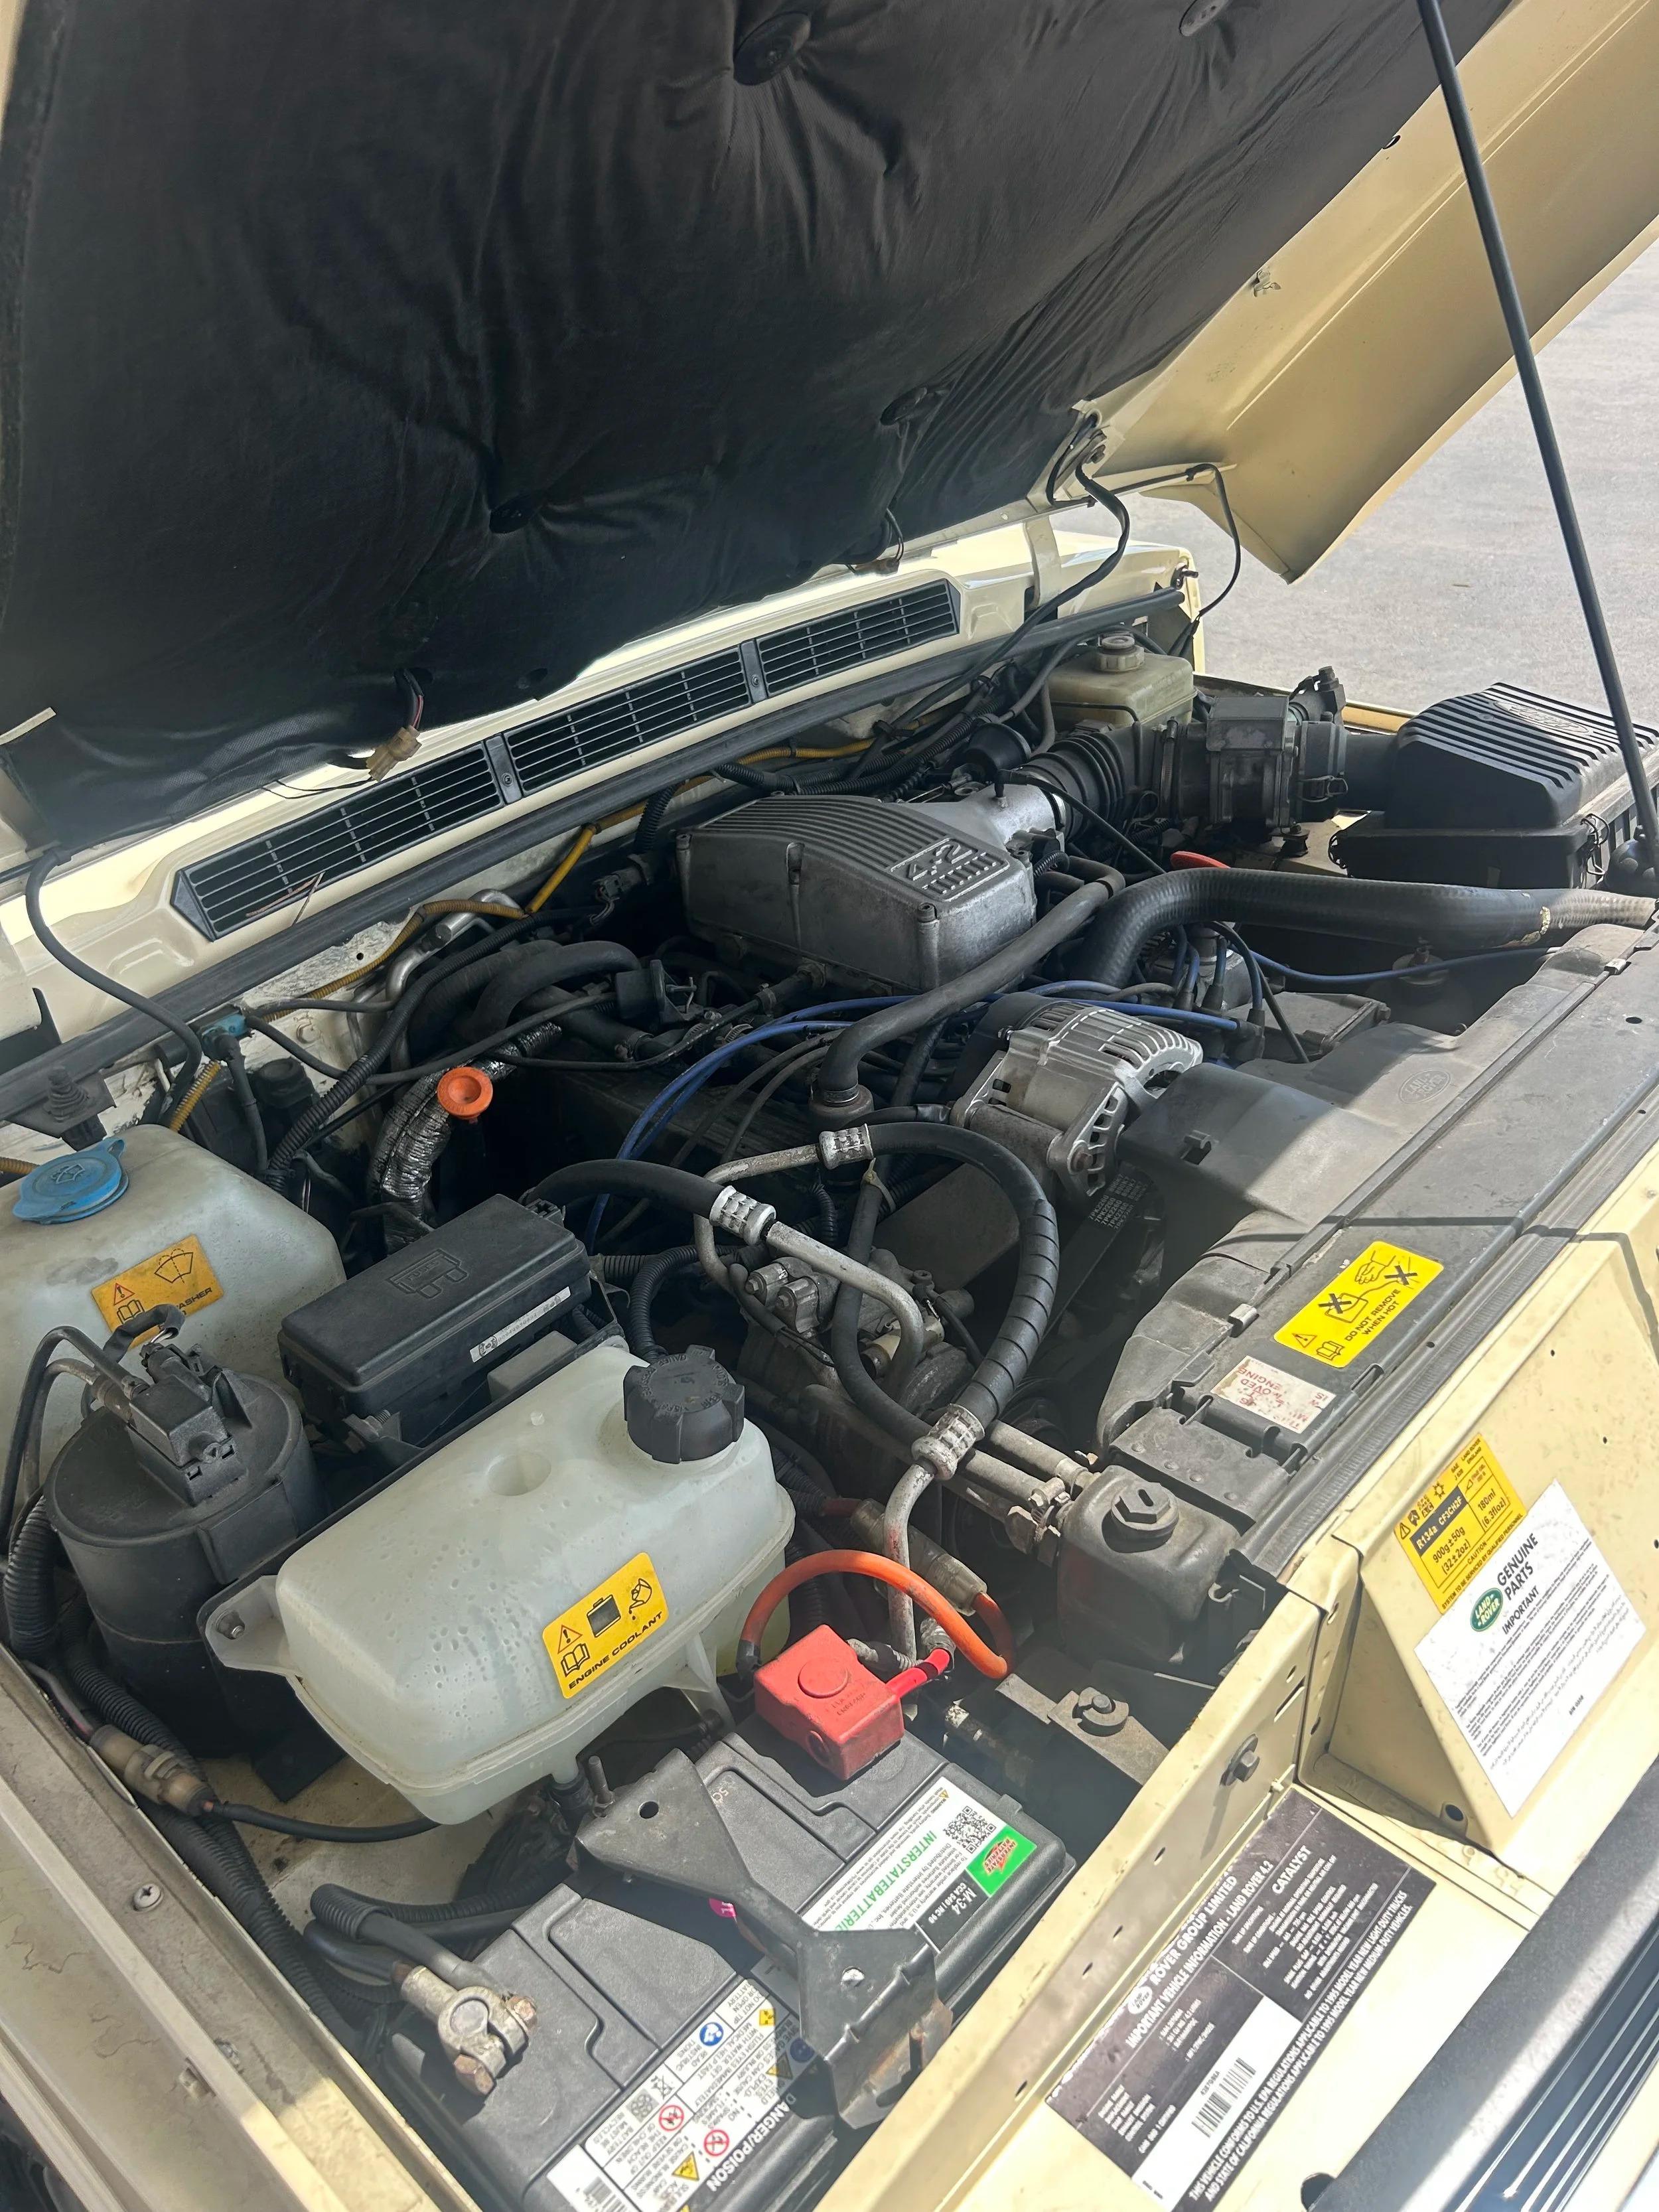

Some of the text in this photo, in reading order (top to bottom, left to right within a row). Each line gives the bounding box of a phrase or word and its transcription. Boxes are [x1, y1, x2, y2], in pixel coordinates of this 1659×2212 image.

[173, 1287, 213, 1313] ASHER
[1344, 1288, 1401, 1342] DO NOT REMOVE
[1361, 1299, 1401, 1336] WHEN HOT
[1236, 1366, 1282, 1390] ENGINE
[1450, 1438, 1481, 1474] SAE LAND ROVER
[1466, 1445, 1482, 1465] ENGLAND
[1477, 1487, 1496, 1512] 180ml
[1415, 1493, 1463, 1551] R134a CF3CH2F
[1441, 1511, 1523, 1609] SYSTEM TO BE SERVICED BY QUALIFIED PERSONNEL
[1467, 1539, 1487, 1565] CAUTION
[1494, 1531, 1539, 1589] GENUINE
[1503, 1559, 1534, 1601] PARTS
[1501, 1584, 1540, 1635] IMPORTANT
[568, 1611, 664, 1690] ENGINE COOLANT
[925, 1841, 952, 1868] Distributed
[939, 1856, 956, 1873] limited
[951, 1849, 962, 1860] For
[958, 1854, 968, 1862] To
[982, 1838, 1011, 1868] BATTERIES
[985, 1840, 1017, 1874] INTERSTATE
[920, 1864, 930, 1873] by
[934, 1874, 950, 1888] under
[944, 1859, 963, 1877] replace
[1269, 1844, 1313, 1895] CATALYST
[887, 1846, 958, 1919] Interstate Batteries authorized dealer
[899, 1870, 924, 1894] Interstate
[914, 1887, 927, 1898] see
[918, 1885, 939, 1905] warranty
[926, 1881, 968, 1924] CCA 540 RC 90
[948, 1886, 978, 1915] M-34
[1387, 1889, 1408, 1914] TRUCKS
[897, 1915, 910, 1927] and
[1388, 1901, 1413, 1932] VEHICLES.
[1147, 1947, 1182, 1986] ROVER
[1175, 1911, 1210, 1951] GROUP
[1202, 1874, 1240, 1915] LIMITED
[1123, 1998, 1167, 2049] IMPORTANT
[1159, 1968, 1190, 2004] VEHICLE
[1182, 1917, 1230, 1974] INFORMATION
[1224, 1893, 1248, 1919] LAND
[1240, 1870, 1266, 1899] ROVER
[1257, 1858, 1275, 1876] 4.2
[1356, 1939, 1373, 1958] NEW
[1346, 1953, 1364, 1973] YEAR
[1352, 1966, 1369, 1984] NEW
[1333, 1967, 1354, 1992] MODEL
[1342, 1978, 1360, 1999] YEAR
[725, 1980, 753, 2008] BATTERY
[731, 1986, 758, 2013] OR OPEN
[1323, 1986, 1340, 2007] 1995
[1329, 1993, 1350, 2019] MODEL
[731, 1991, 764, 2025] DO NOT TIP
[1317, 2001, 1331, 2015] TO
[1293, 2009, 1325, 2049] APPLICABLE
[1312, 2028, 1327, 2043] TO
[1319, 2014, 1336, 2033] 1995
[689, 2049, 708, 2068] READ
[695, 2020, 753, 2080] MEDICAL HELP FAST
[709, 2026, 758, 2079] WITH GET
[1289, 2037, 1321, 2078] APPLICABLE
[693, 2031, 764, 2108] FLUSH EYES IMMEDIATELY
[750, 2061, 766, 2077] CAN
[1265, 2043, 1301, 2090] REGULATIONS
[732, 2073, 754, 2097] CAUSE
[1256, 2085, 1273, 2102] EPA
[1260, 2072, 1297, 2120] REGULATIONS
[700, 2099, 725, 2126] FLAMES
[727, 2107, 741, 2122] NO
[1242, 2108, 1256, 2124] TO
[1248, 2096, 1265, 2114] U.S.
[704, 2089, 798, 2195] DANGER/POISON
[1217, 2117, 1250, 2160] CONFORMS
[1234, 2114, 1267, 2158] CALIFORNIA
[1198, 2153, 1226, 2187] VEHICLE
[1227, 2151, 1242, 2168] OF
[1214, 2161, 1235, 2187] STATE
[1187, 2179, 1206, 2202] THIS
[1203, 2180, 1222, 2203] AND
